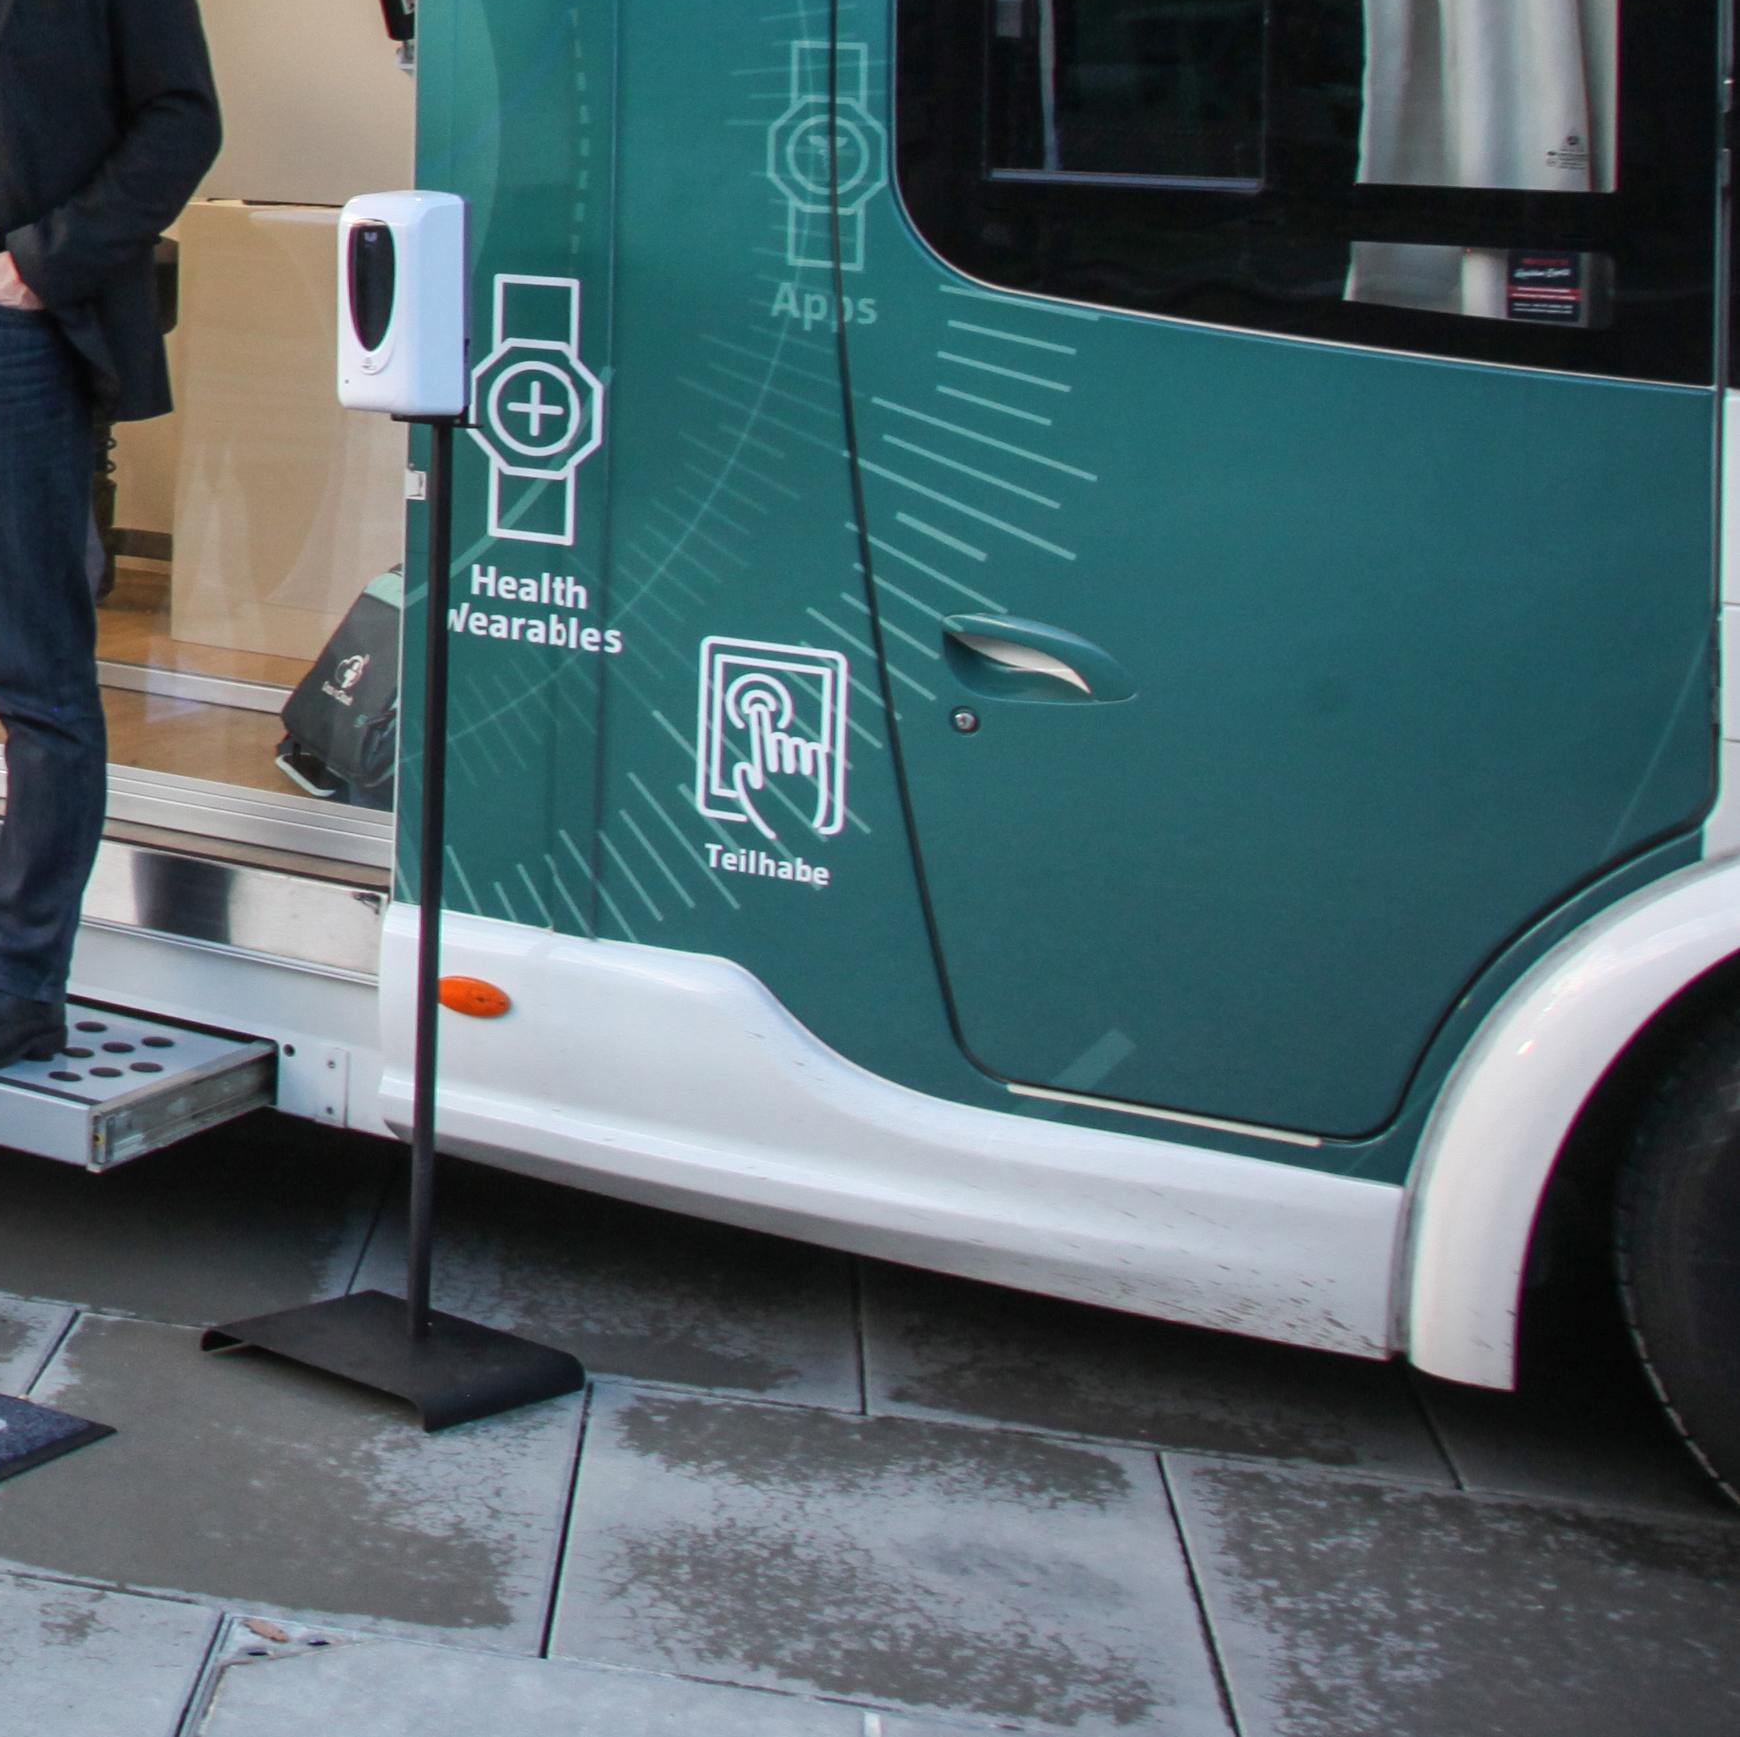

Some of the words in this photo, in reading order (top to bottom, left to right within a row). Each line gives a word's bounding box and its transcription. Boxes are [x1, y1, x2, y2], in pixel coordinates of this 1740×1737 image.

[769, 281, 879, 334] Apps
[471, 563, 588, 610] Health
[446, 601, 623, 654] Wearables
[704, 842, 831, 886] Teilhabe
